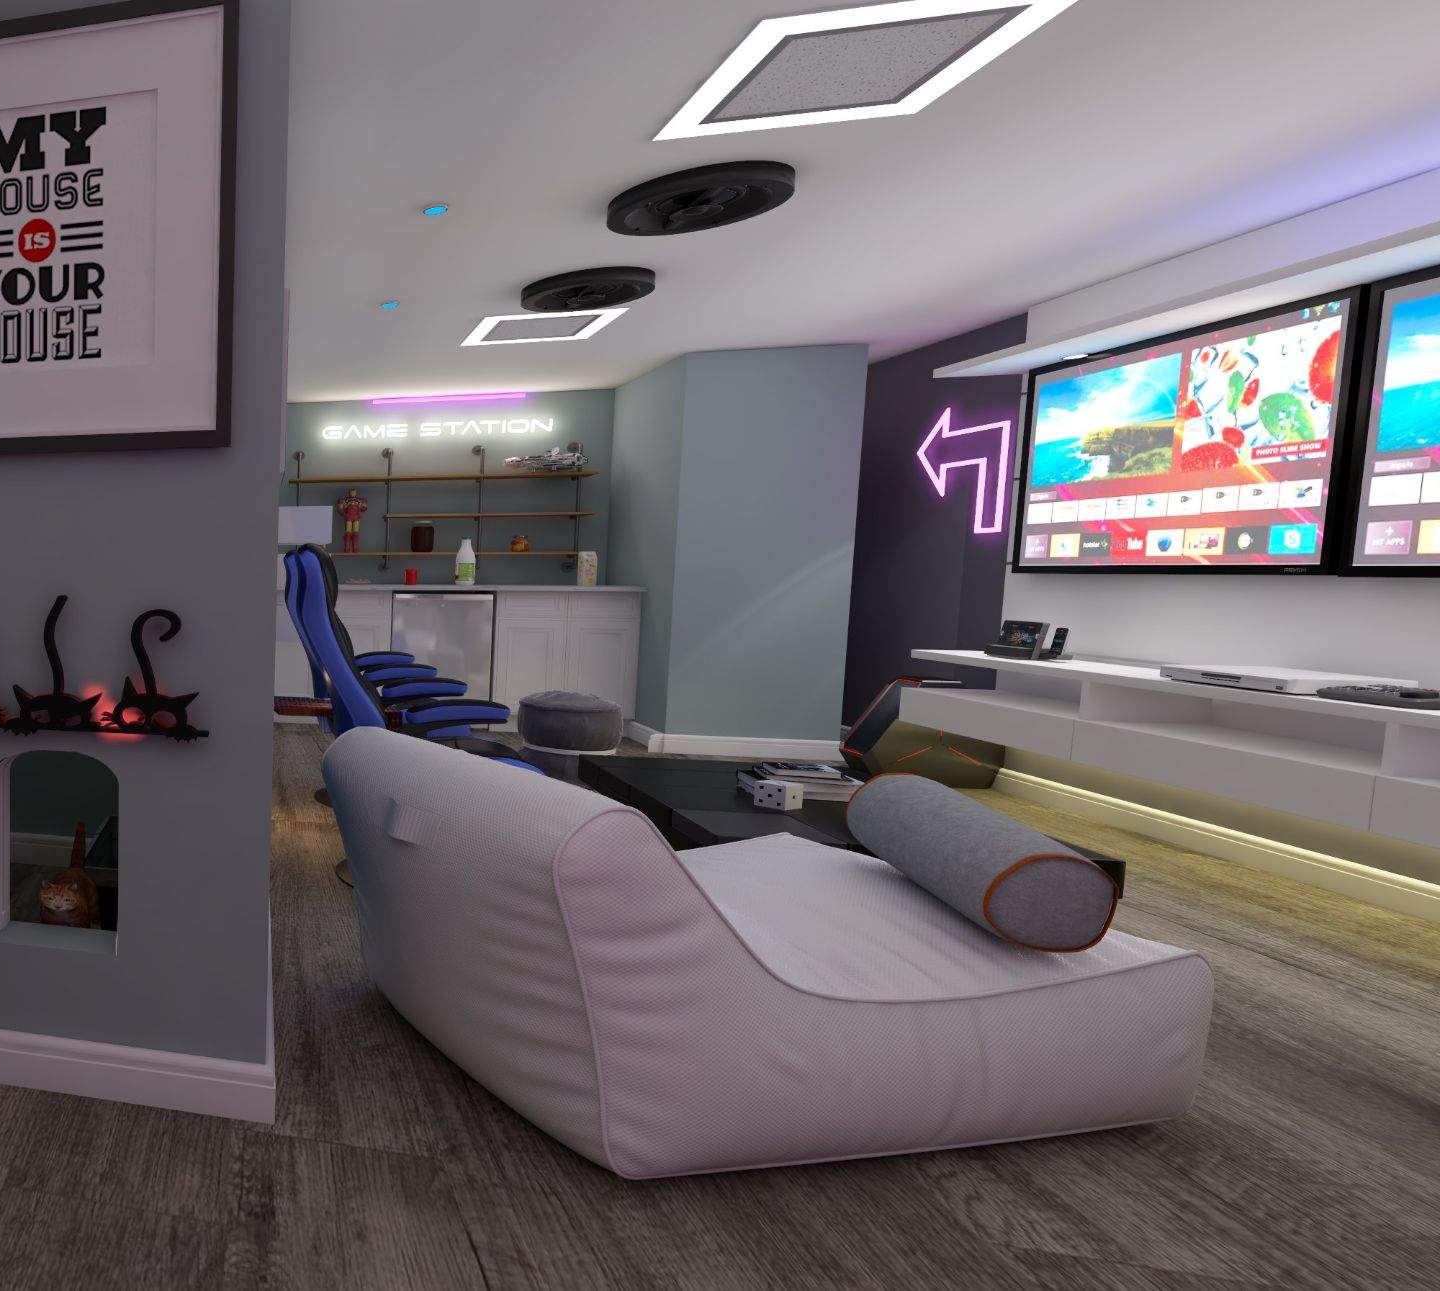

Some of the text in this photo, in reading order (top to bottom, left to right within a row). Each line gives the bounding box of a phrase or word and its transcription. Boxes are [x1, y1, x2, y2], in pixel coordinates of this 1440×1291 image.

[23, 231, 50, 252] IS
[321, 416, 555, 441] GAME STATION
[1256, 442, 1322, 456] PHOTO SLIDE SHOW
[1385, 537, 1405, 546] APPS
